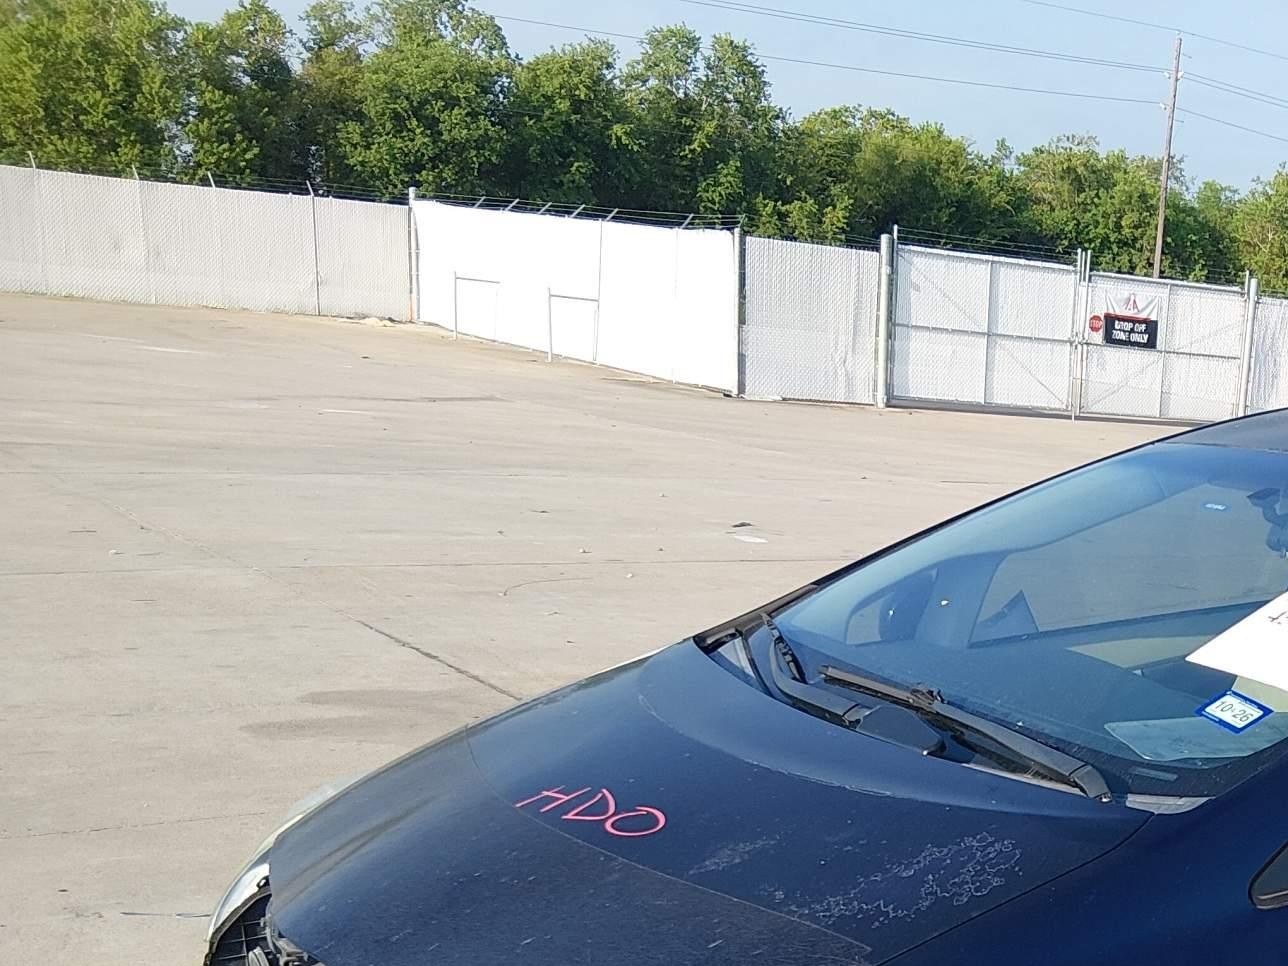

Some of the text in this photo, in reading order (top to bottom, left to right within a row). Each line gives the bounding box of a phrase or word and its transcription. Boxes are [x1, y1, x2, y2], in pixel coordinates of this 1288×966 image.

[1114, 320, 1147, 332] DROP OFF
[1112, 330, 1149, 343] ZONE ONLY
